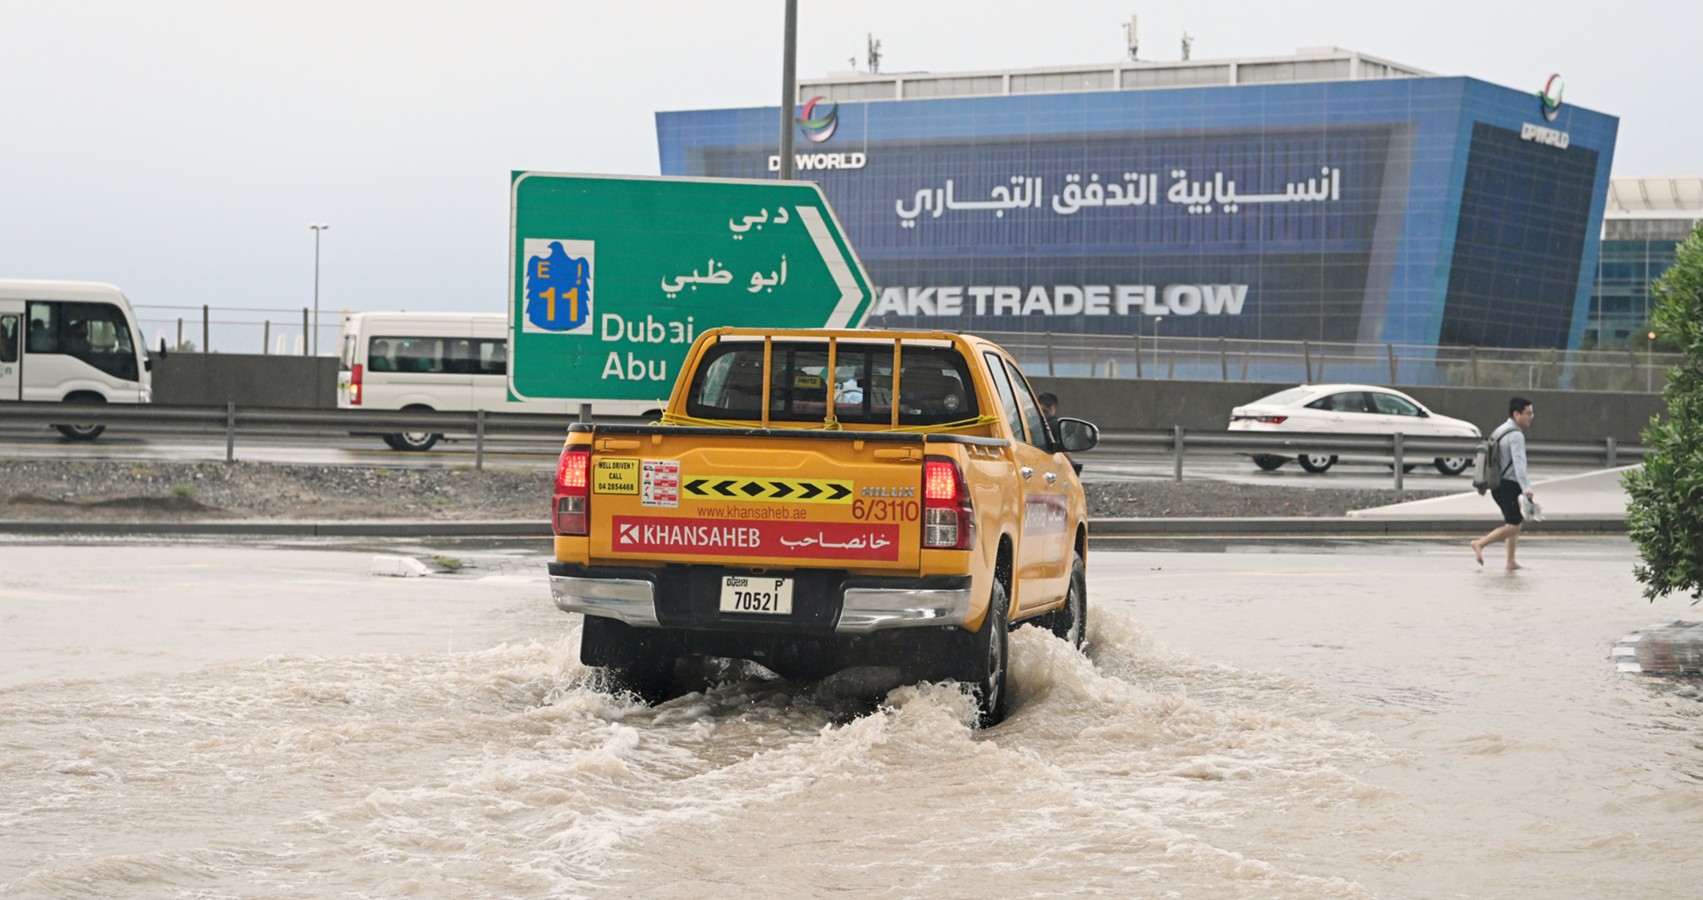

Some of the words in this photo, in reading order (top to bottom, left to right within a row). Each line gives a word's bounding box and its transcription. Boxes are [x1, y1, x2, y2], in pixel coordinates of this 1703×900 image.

[795, 152, 867, 170] WORLD
[1052, 172, 1158, 215] التدفق
[729, 206, 789, 240] دبي
[537, 261, 551, 279] E
[661, 258, 733, 299] ظبي
[747, 253, 787, 293] أبو
[539, 286, 578, 322] 11
[871, 286, 963, 316] AKE
[968, 285, 1110, 316] TRADE
[1116, 285, 1249, 316] FLOW
[601, 313, 694, 344] Dubai
[601, 351, 666, 381] Abu
[598, 461, 612, 469] WELL
[612, 462, 630, 470] DRIVEN
[861, 486, 916, 497] HILUX
[697, 505, 807, 520] www.khansaheb.ae
[852, 499, 919, 522] 6/3110
[643, 524, 761, 548] KHANSAHEB
[774, 579, 784, 591] P
[734, 591, 778, 612] 70521
